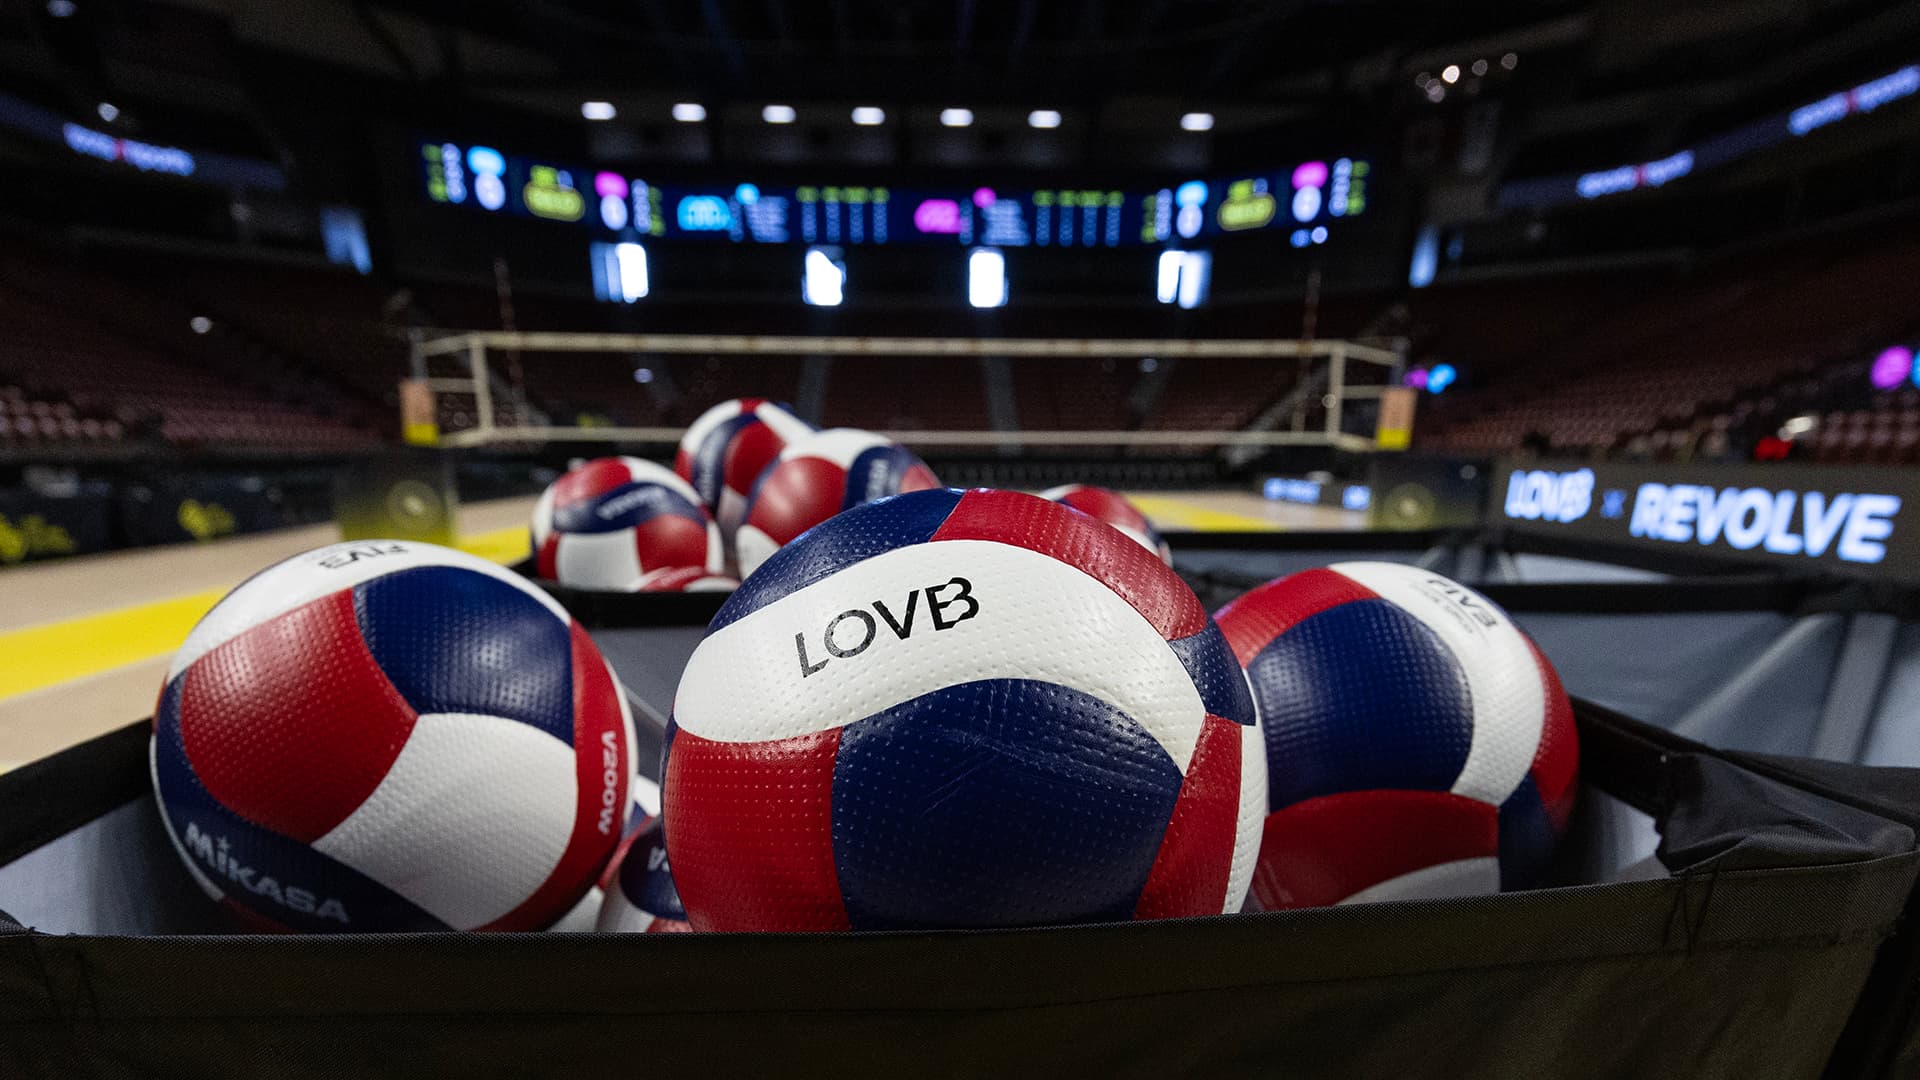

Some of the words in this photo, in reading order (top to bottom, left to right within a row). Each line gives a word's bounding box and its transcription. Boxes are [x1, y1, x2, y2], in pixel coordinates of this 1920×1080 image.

[1505, 469, 1594, 523] LOVB
[1630, 482, 1902, 563] REVOLVE
[795, 577, 979, 678] LOVB
[598, 730, 618, 835] V200W
